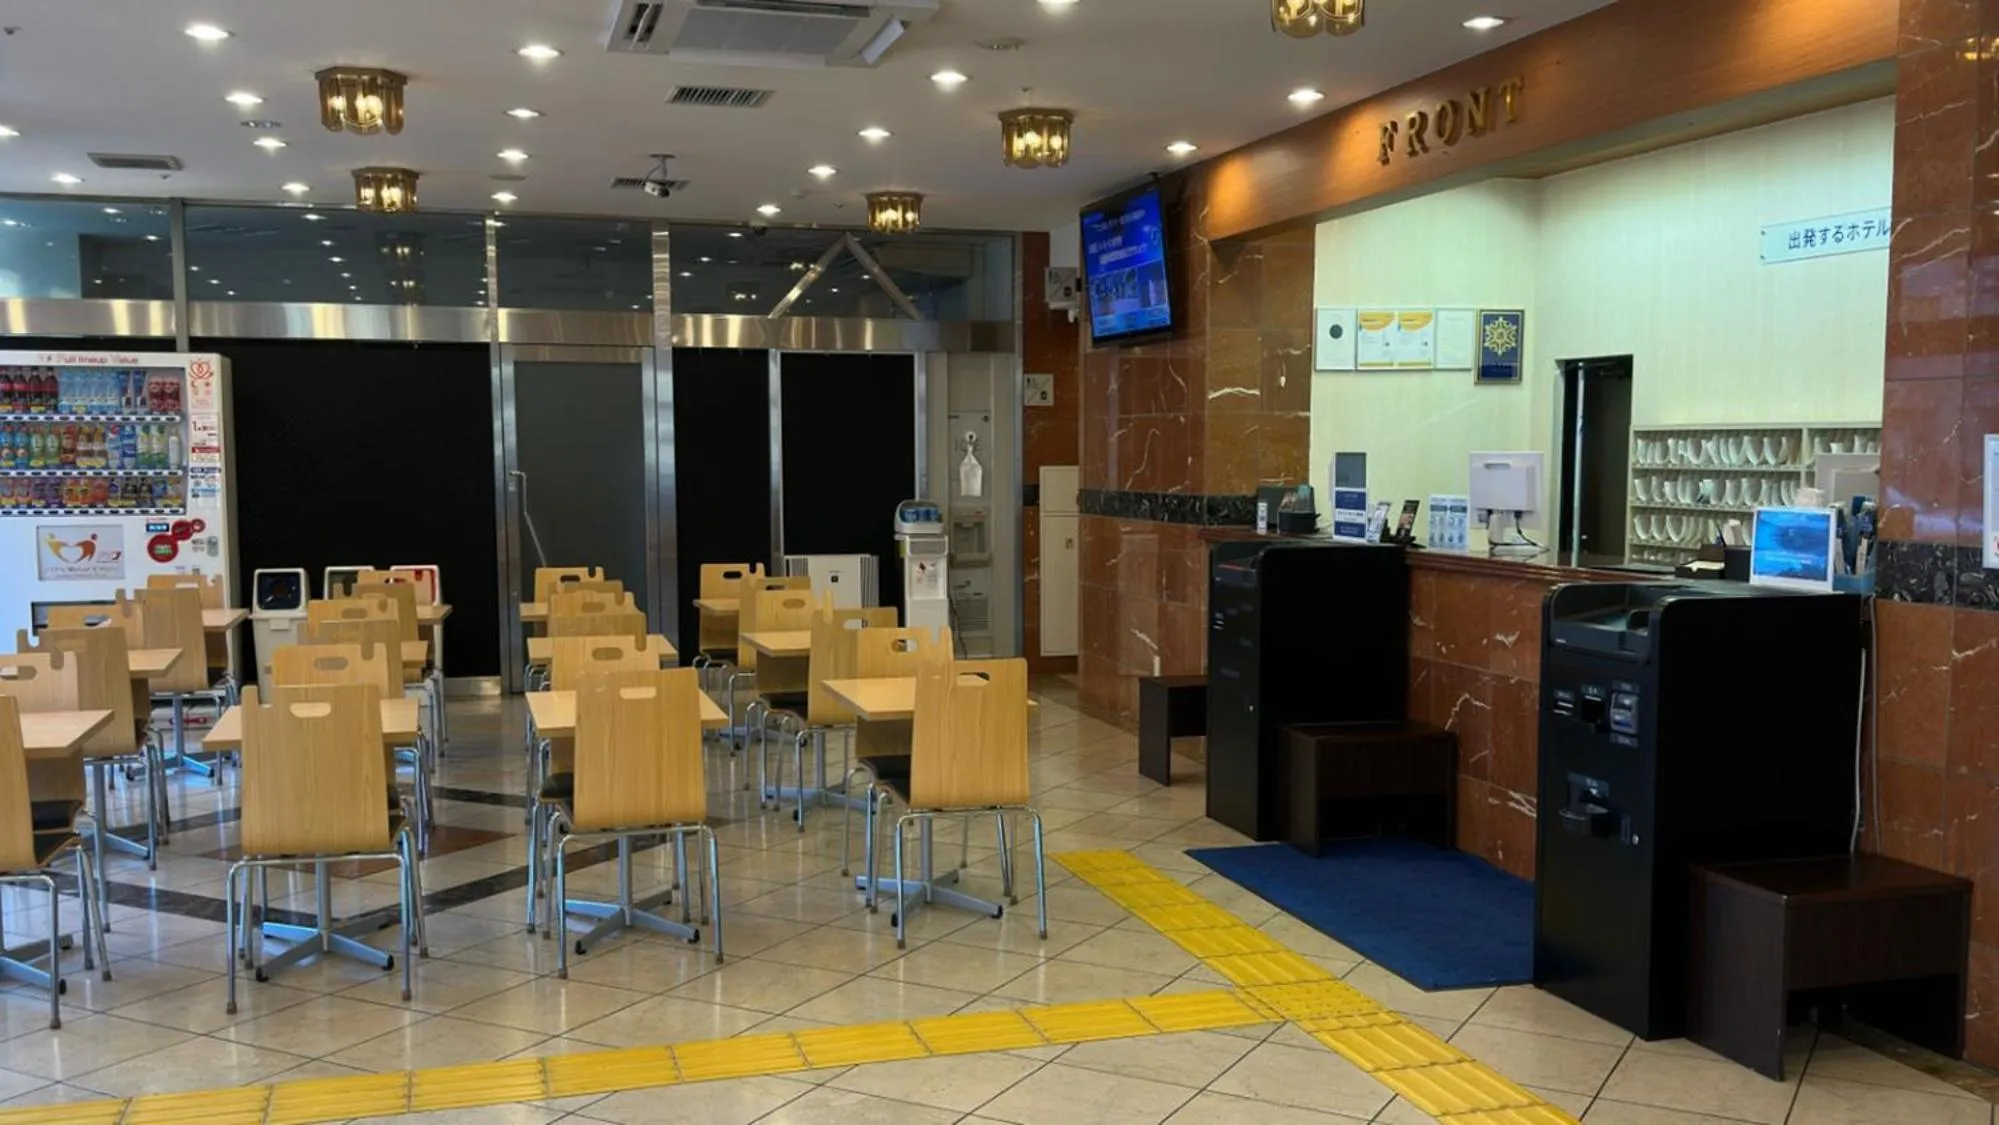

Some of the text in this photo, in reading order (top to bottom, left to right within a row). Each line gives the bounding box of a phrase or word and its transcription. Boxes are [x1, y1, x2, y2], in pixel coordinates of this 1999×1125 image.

[1378, 76, 1525, 164] FRONT
[1787, 217, 1891, 250] 出発するホテル
